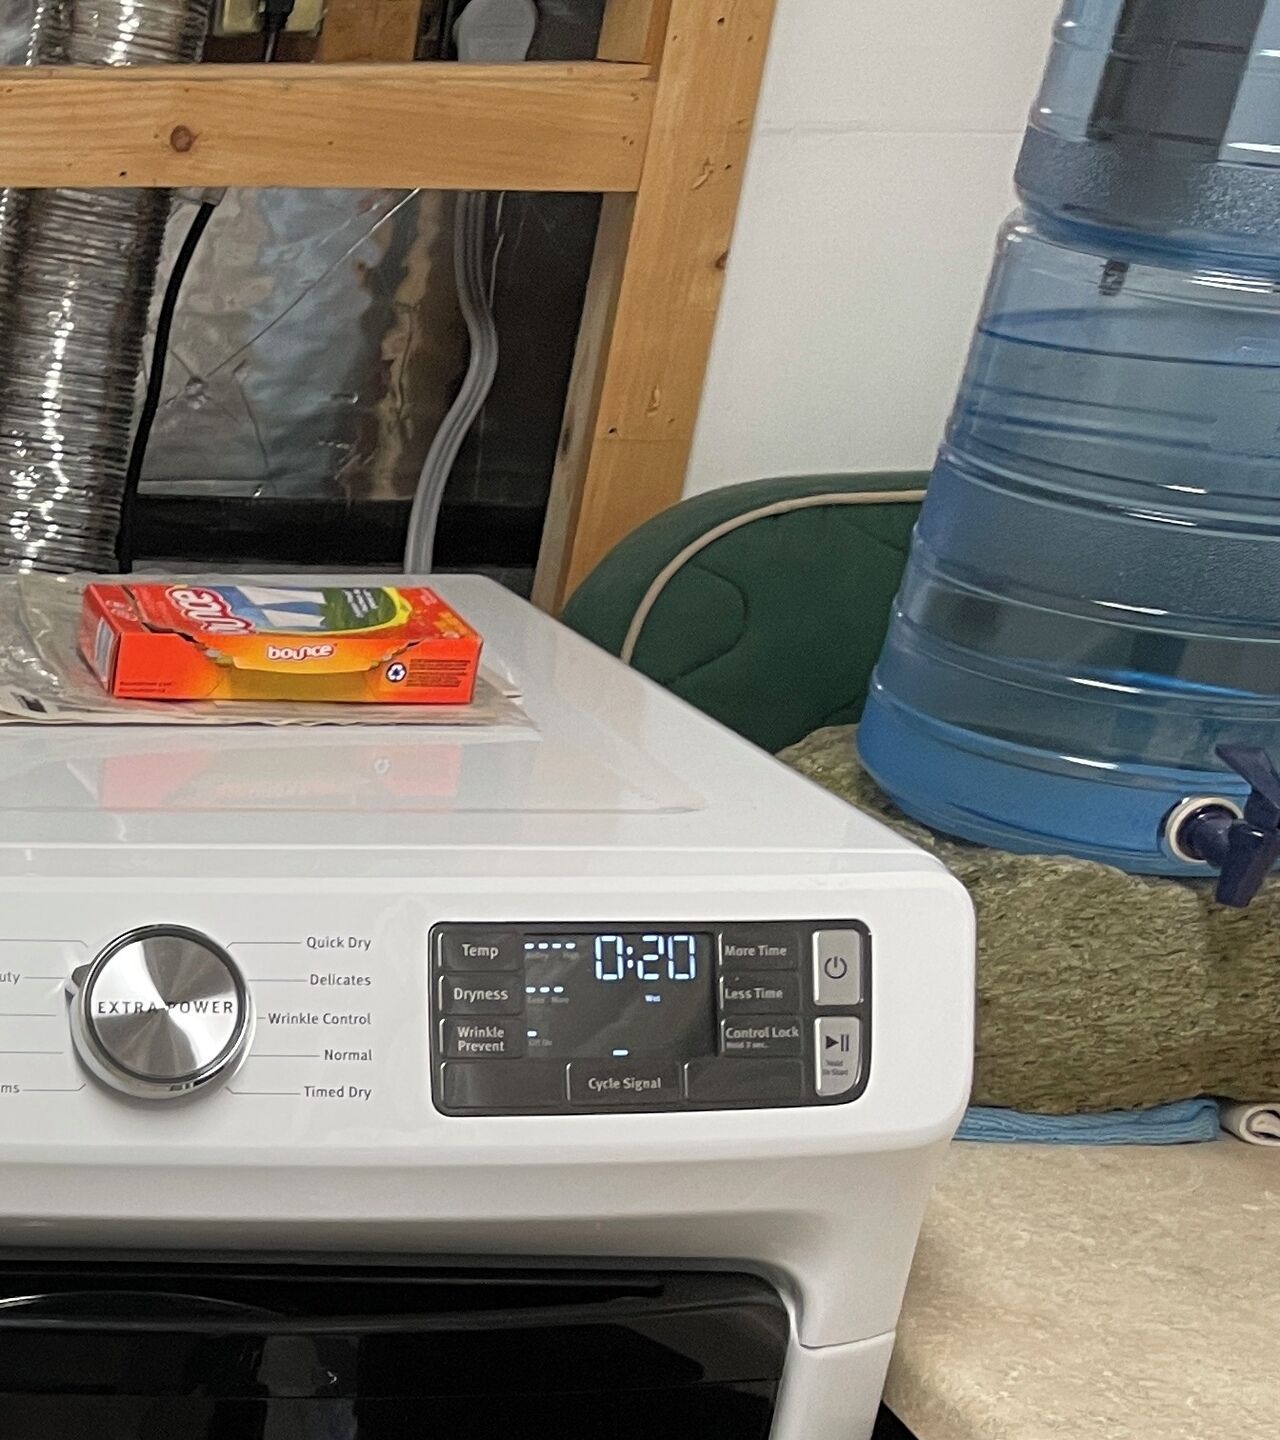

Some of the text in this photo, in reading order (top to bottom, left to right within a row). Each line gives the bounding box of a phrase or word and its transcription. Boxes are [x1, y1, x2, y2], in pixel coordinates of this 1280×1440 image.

[267, 644, 334, 661] bounce
[306, 936, 371, 951] Quick Dry
[461, 944, 499, 960] Temp
[594, 935, 696, 980] 0:20
[725, 945, 787, 957] More Time
[310, 973, 371, 986] Delicates
[453, 988, 508, 1003] Dryness
[725, 988, 783, 1000] Less Time
[98, 1001, 233, 1014] EXTRA POWER
[268, 1013, 371, 1025] Wrinkle Control
[457, 1026, 504, 1039] Wrinkle
[725, 1026, 800, 1038] Control Lock
[457, 1040, 505, 1052] Prevent
[324, 1049, 372, 1061] Normal
[588, 1077, 661, 1092] Cycle Signal
[304, 1086, 372, 1100] Timed Dry
